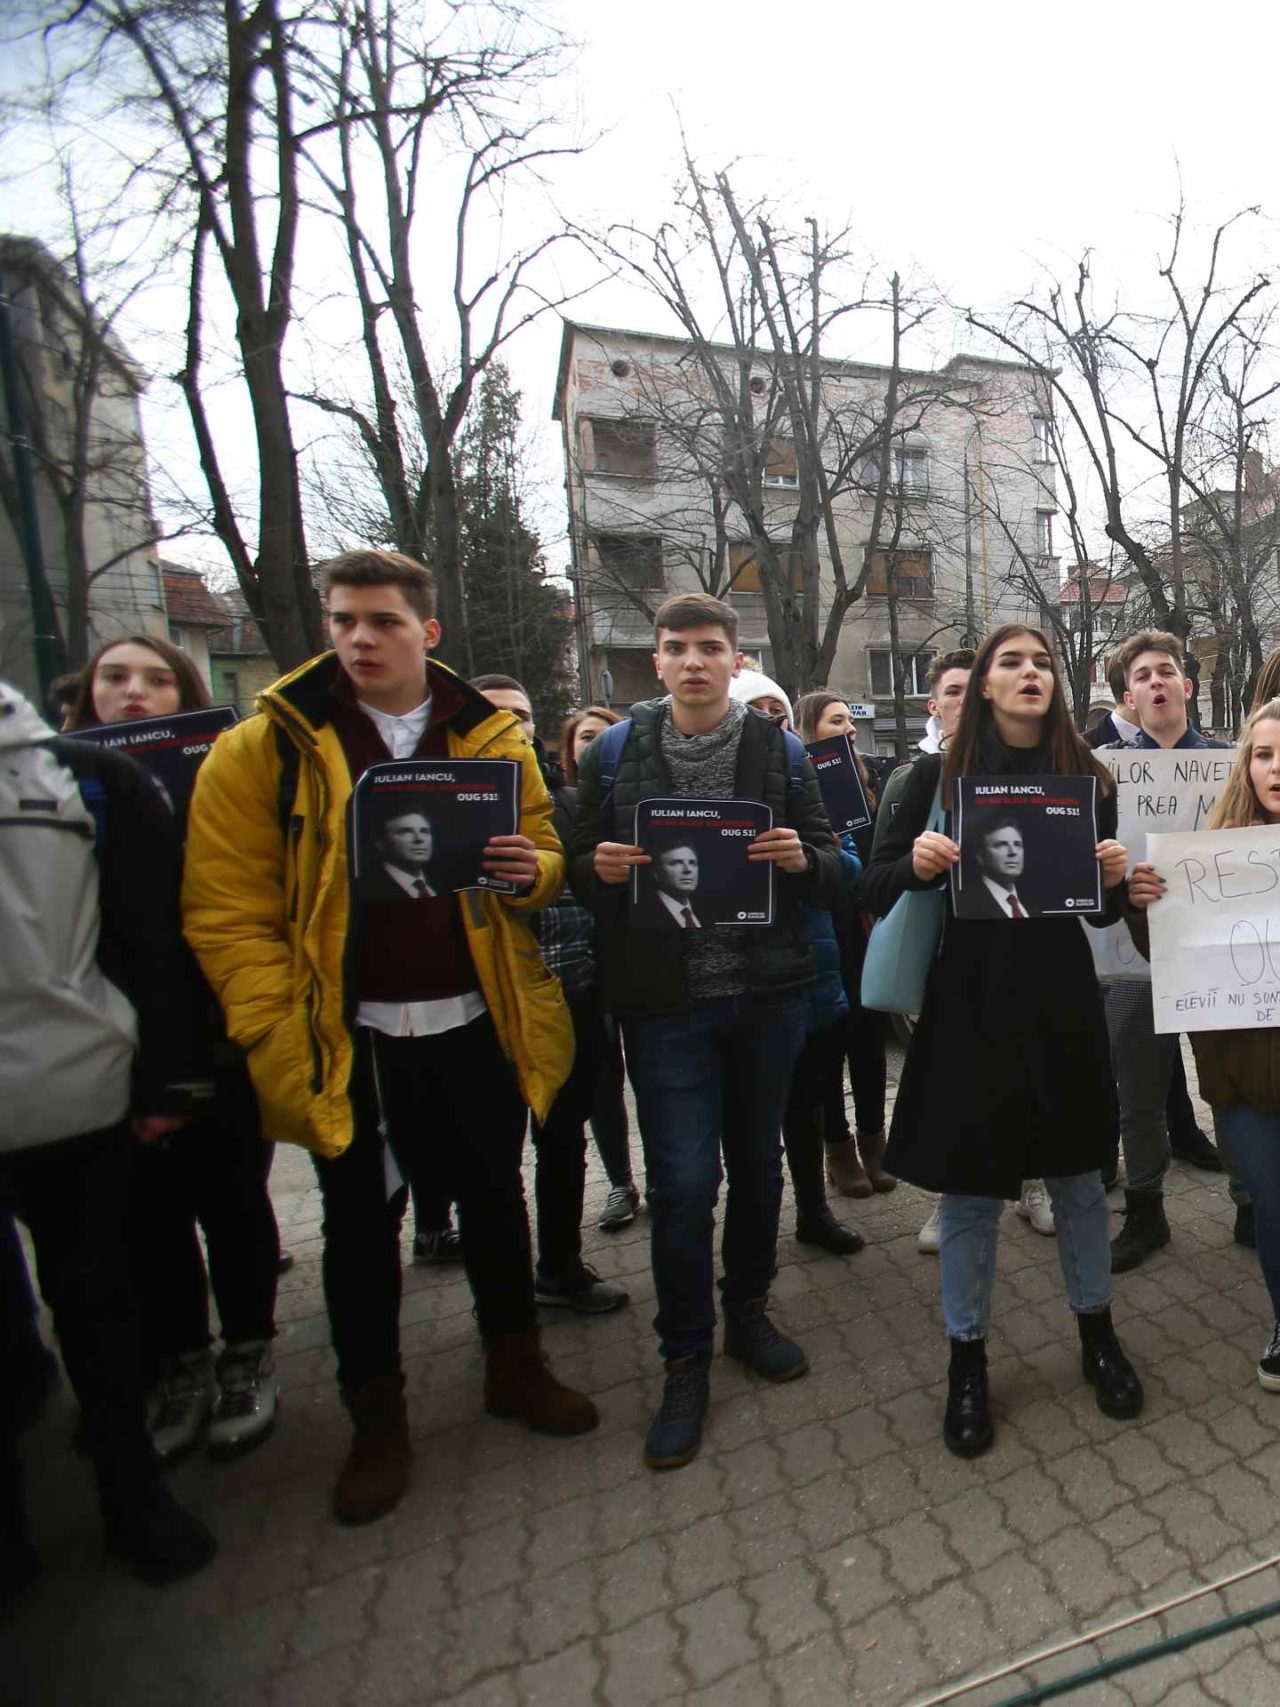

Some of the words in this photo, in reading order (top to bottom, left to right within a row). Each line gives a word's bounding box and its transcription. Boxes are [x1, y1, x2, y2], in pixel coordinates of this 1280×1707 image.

[130, 729, 176, 745] IANCU,
[183, 743, 209, 756] OUG
[817, 760, 832, 770] OUG
[374, 773, 412, 784] IULIAN
[415, 772, 456, 783] IANCU,
[975, 786, 1008, 795] IULIAN
[1010, 785, 1045, 796] IANCU,
[457, 793, 480, 802] OUG
[482, 793, 498, 801] 51!
[1046, 806, 1066, 815] OUG
[1066, 807, 1080, 816] 51!
[1137, 794, 1178, 817] PREA
[651, 809, 684, 818] IULIAN
[686, 810, 721, 819] IANCU,
[721, 828, 742, 837] OUG
[742, 829, 756, 837] 51!
[1228, 994, 1246, 1007] NU
[1256, 1008, 1275, 1022] DE
